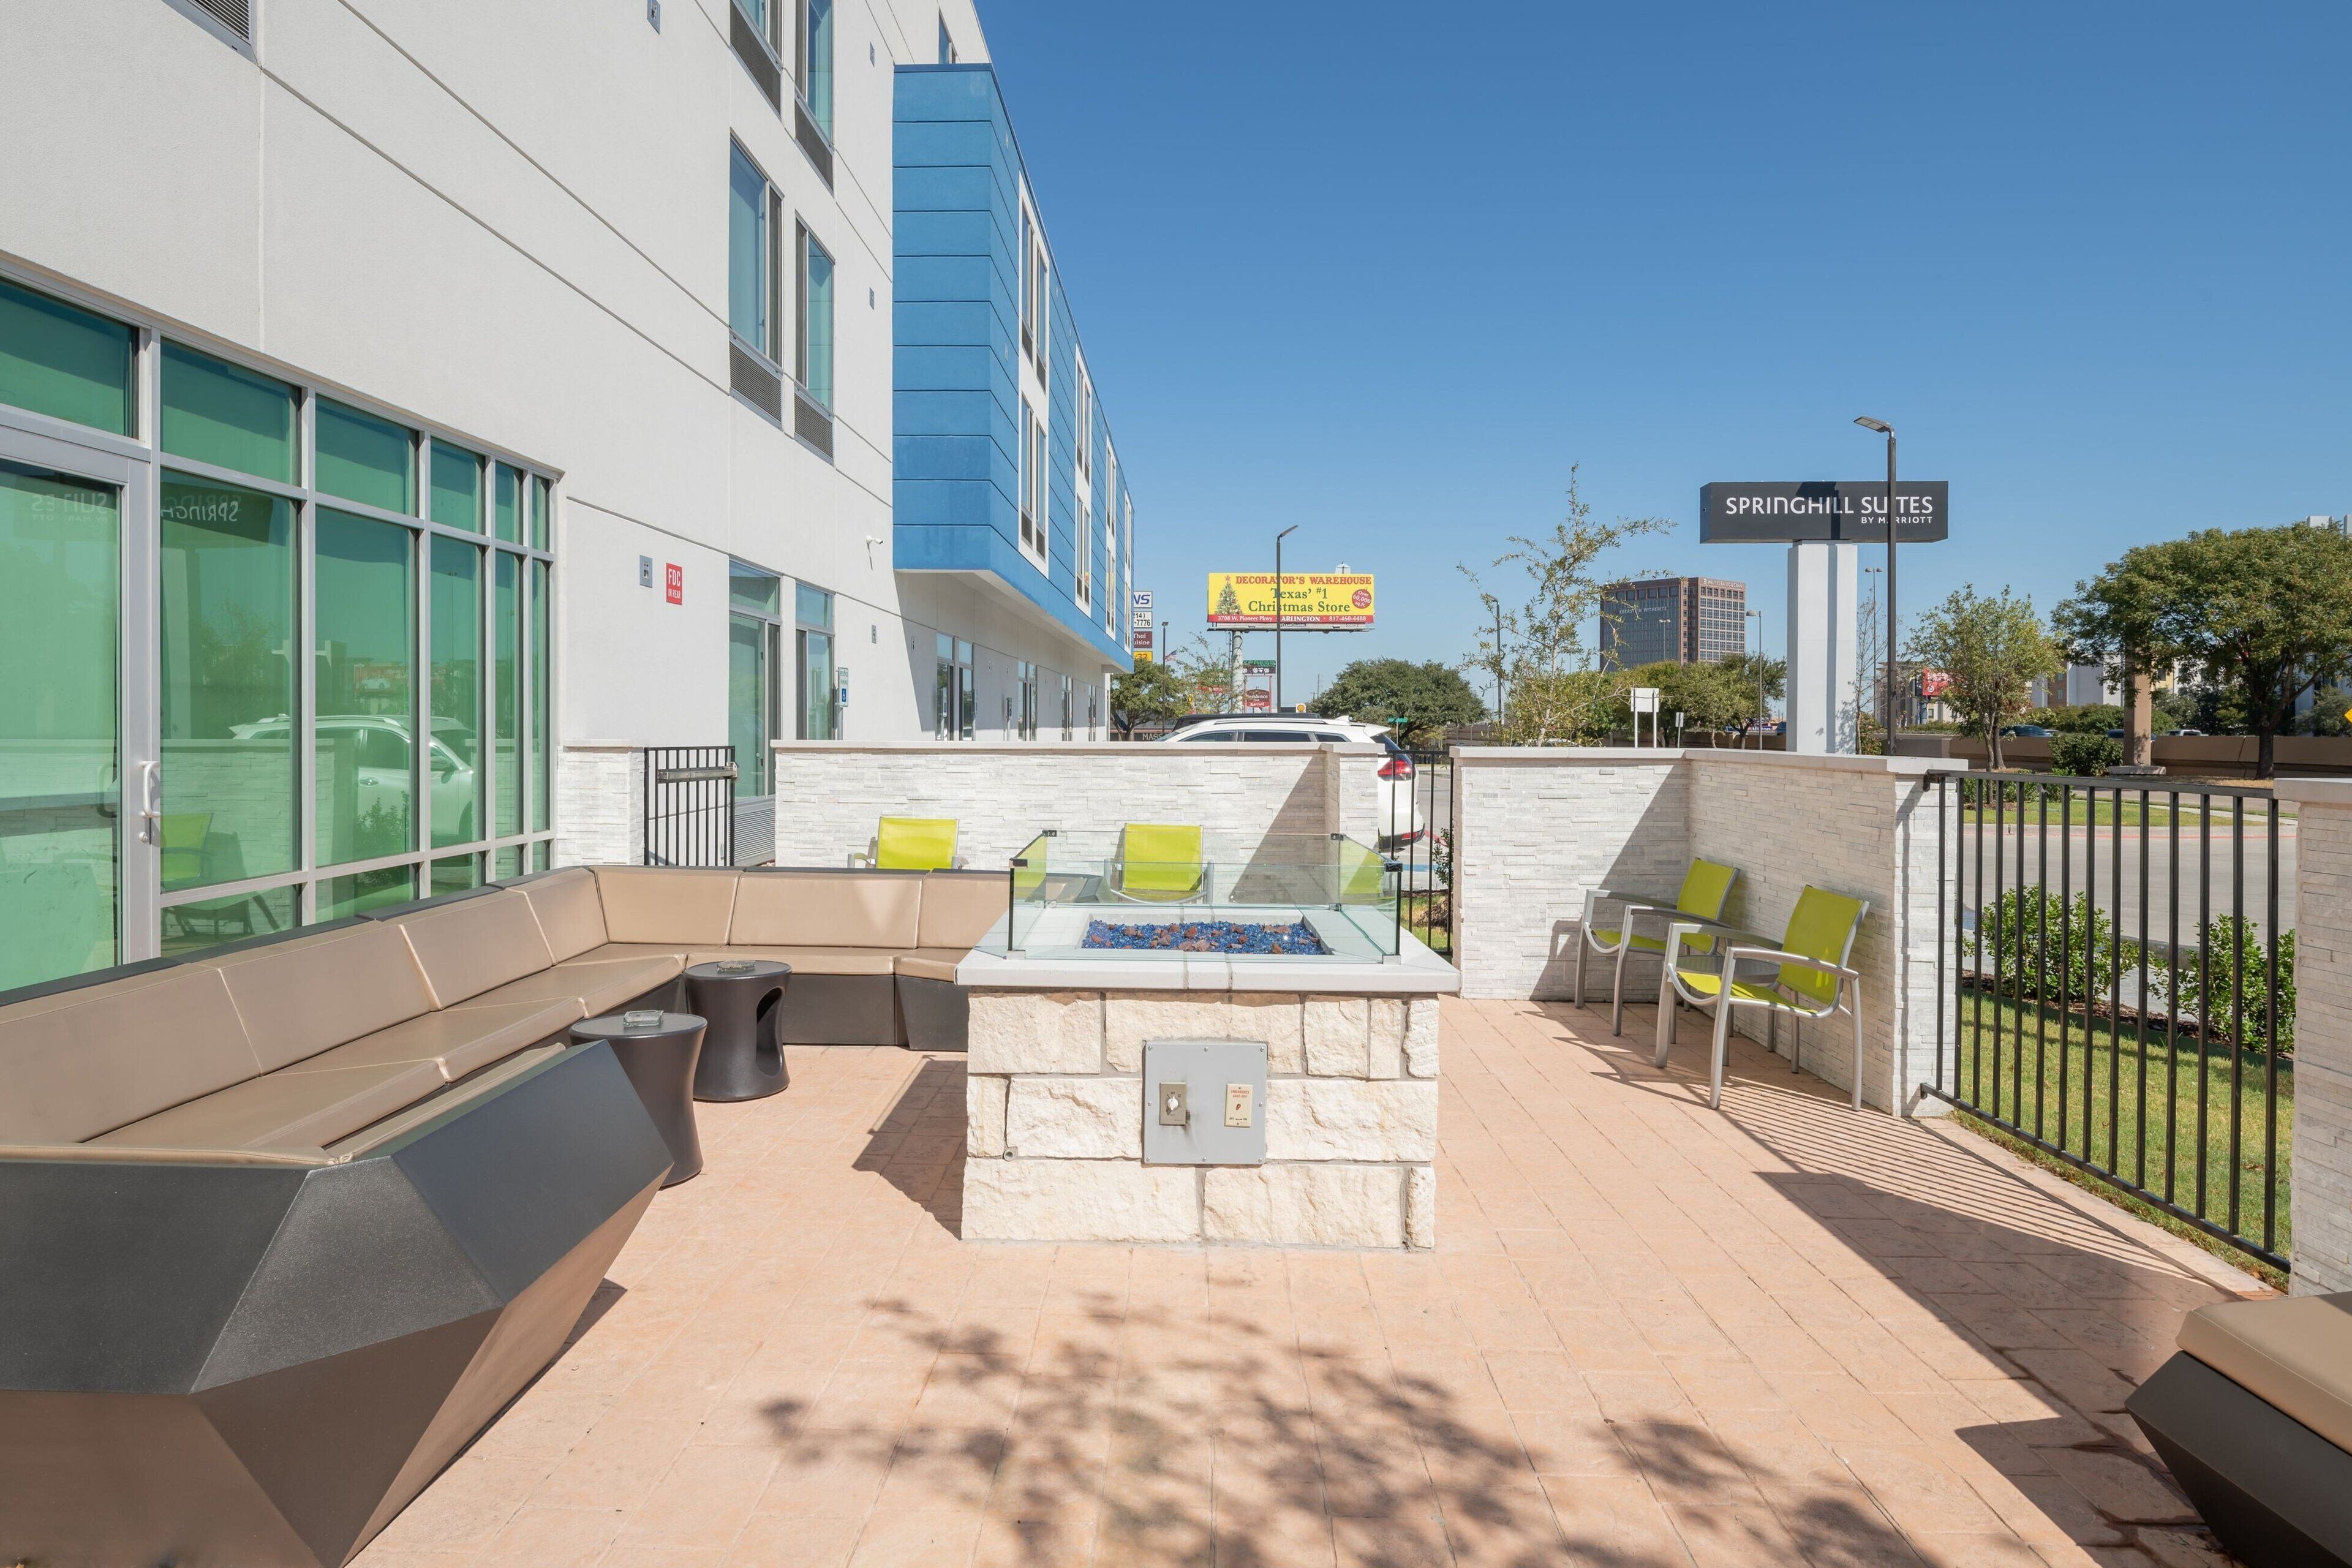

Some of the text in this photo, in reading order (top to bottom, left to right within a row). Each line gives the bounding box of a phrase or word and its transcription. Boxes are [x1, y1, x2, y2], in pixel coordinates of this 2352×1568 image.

[1725, 496, 1933, 514] SPRINGHILL SUTES
[668, 568, 681, 587] FDC
[668, 589, 681, 599] IN REAR
[1270, 587, 1328, 599] Texas' #1
[1352, 594, 1371, 604] 60,000
[1318, 601, 1351, 612] Store
